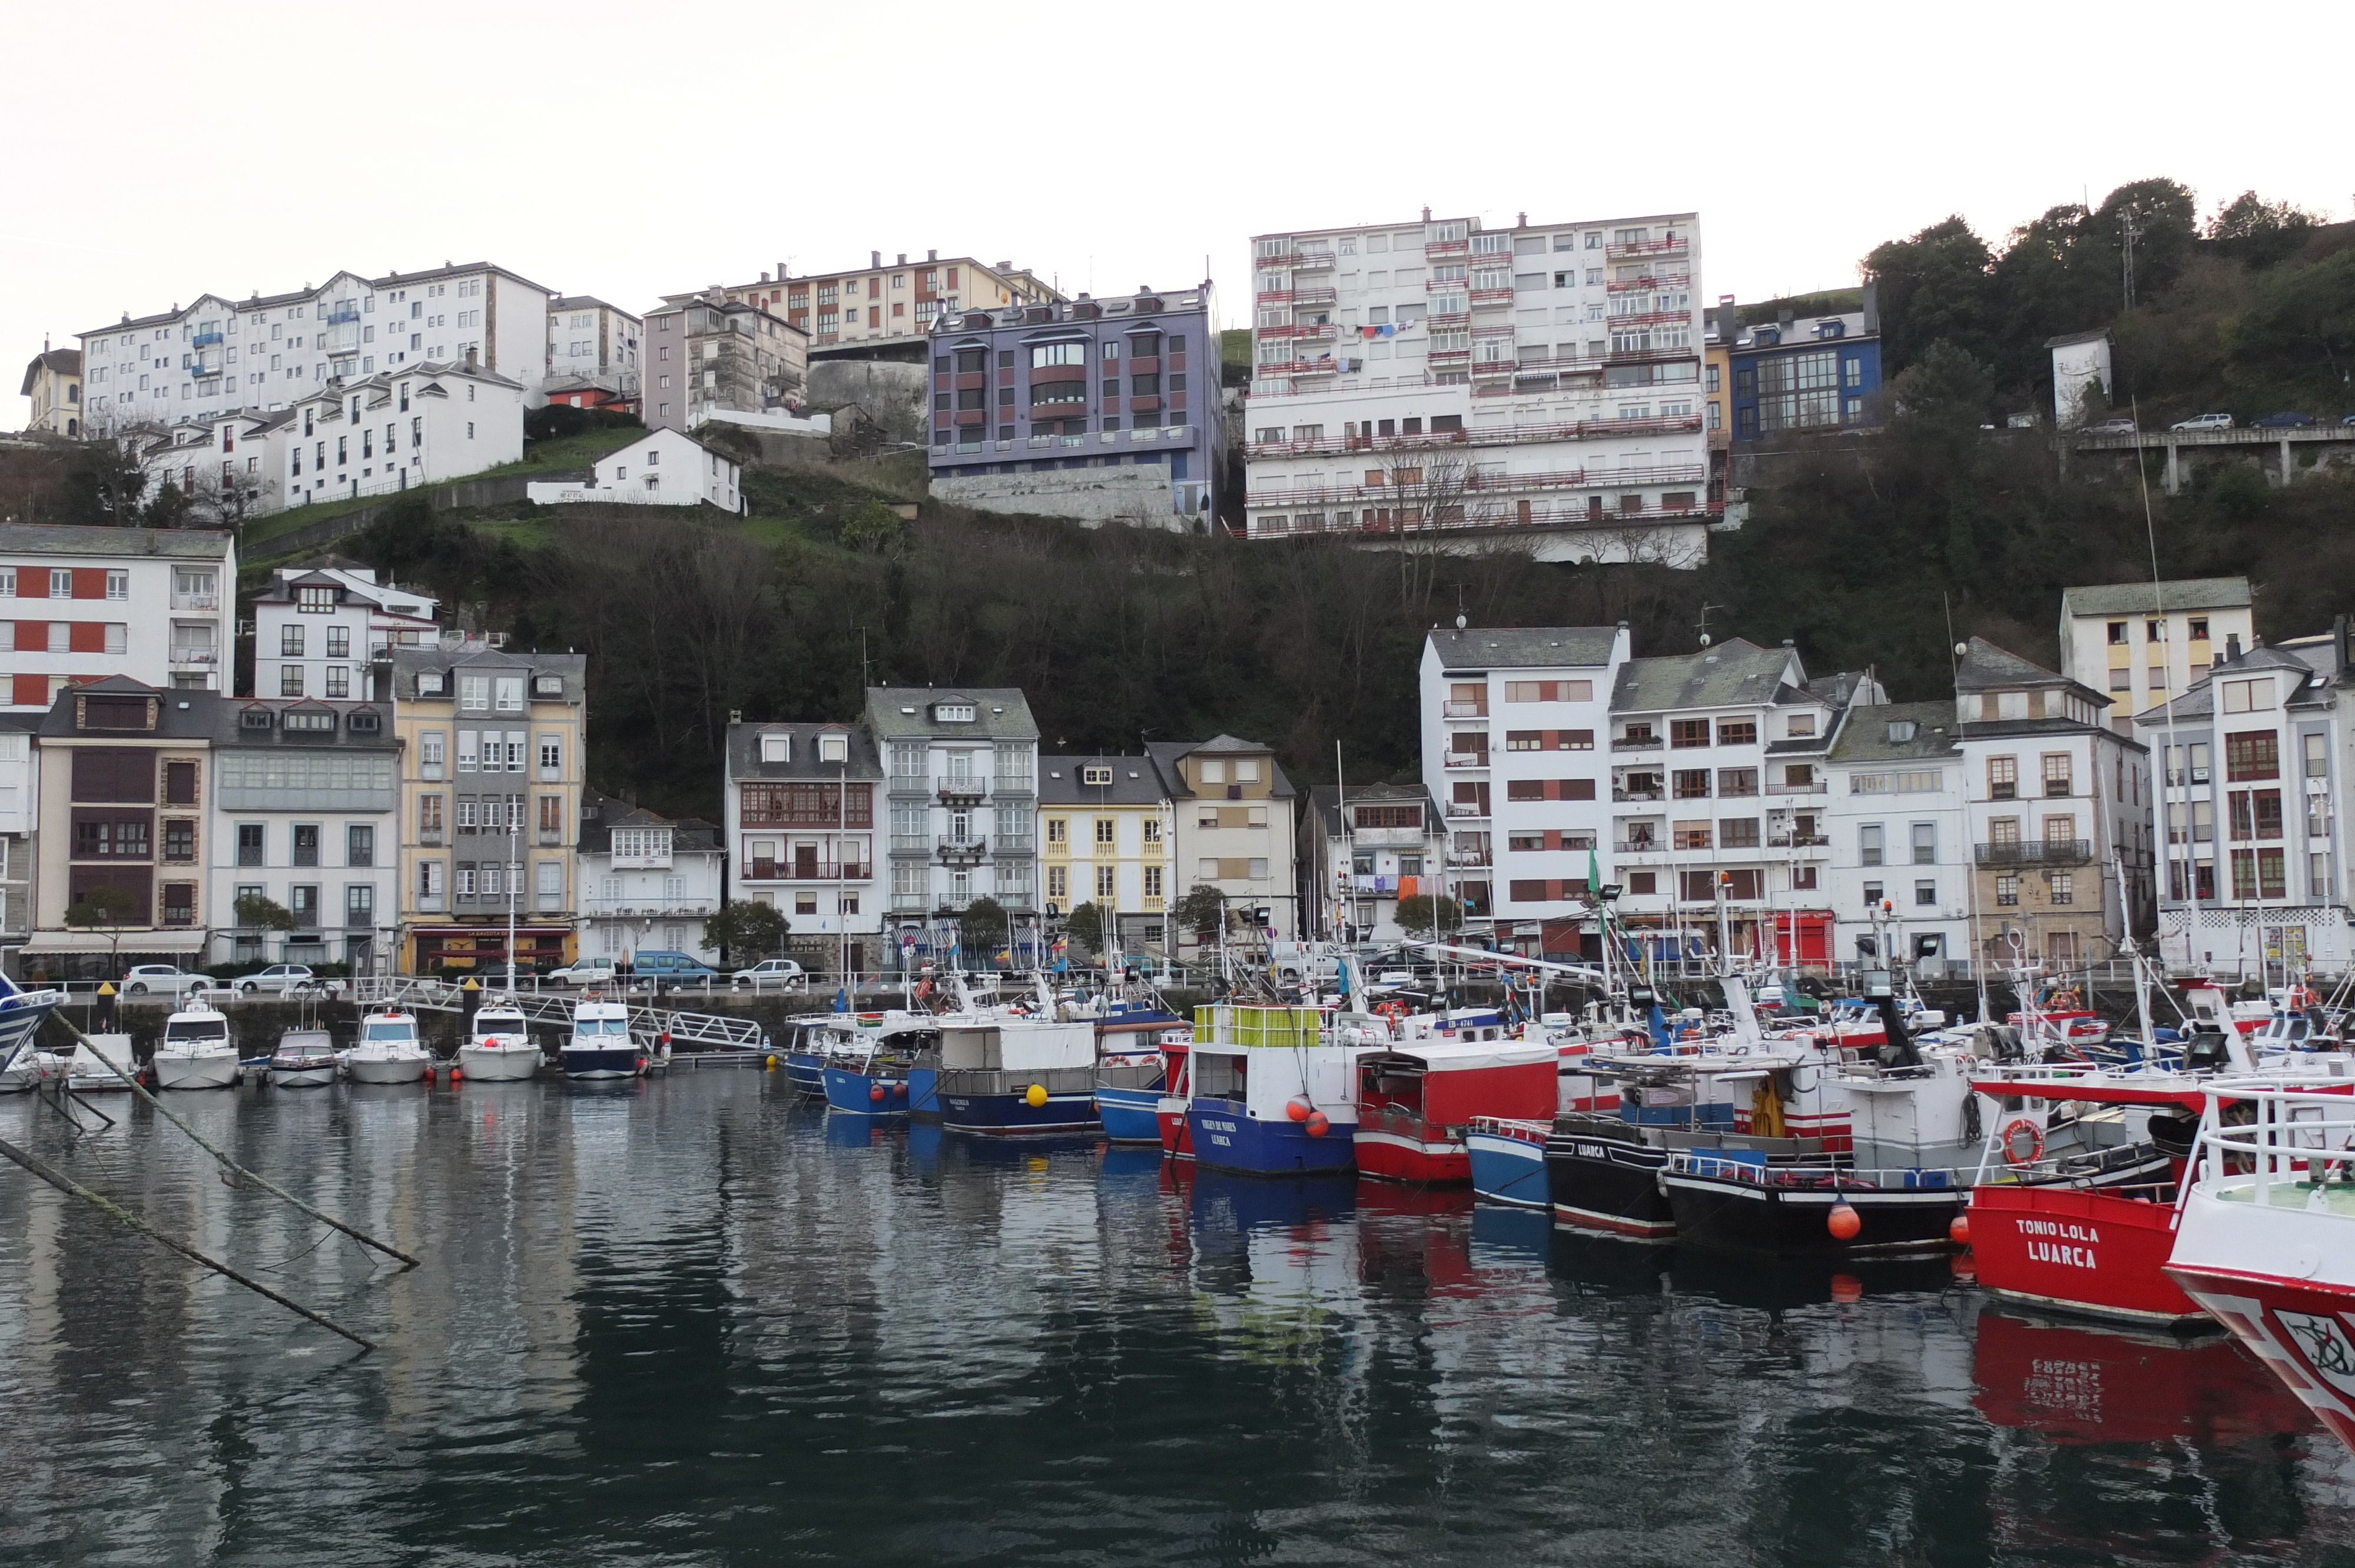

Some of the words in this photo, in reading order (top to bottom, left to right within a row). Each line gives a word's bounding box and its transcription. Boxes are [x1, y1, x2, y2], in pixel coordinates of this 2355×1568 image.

[1211, 1134, 1231, 1147] LUARCA
[1578, 1144, 1605, 1158] LUARCA
[2016, 1220, 2057, 1235] TONIO
[2059, 1223, 2099, 1243] LOLA
[2028, 1241, 2097, 1270] LUARCA
